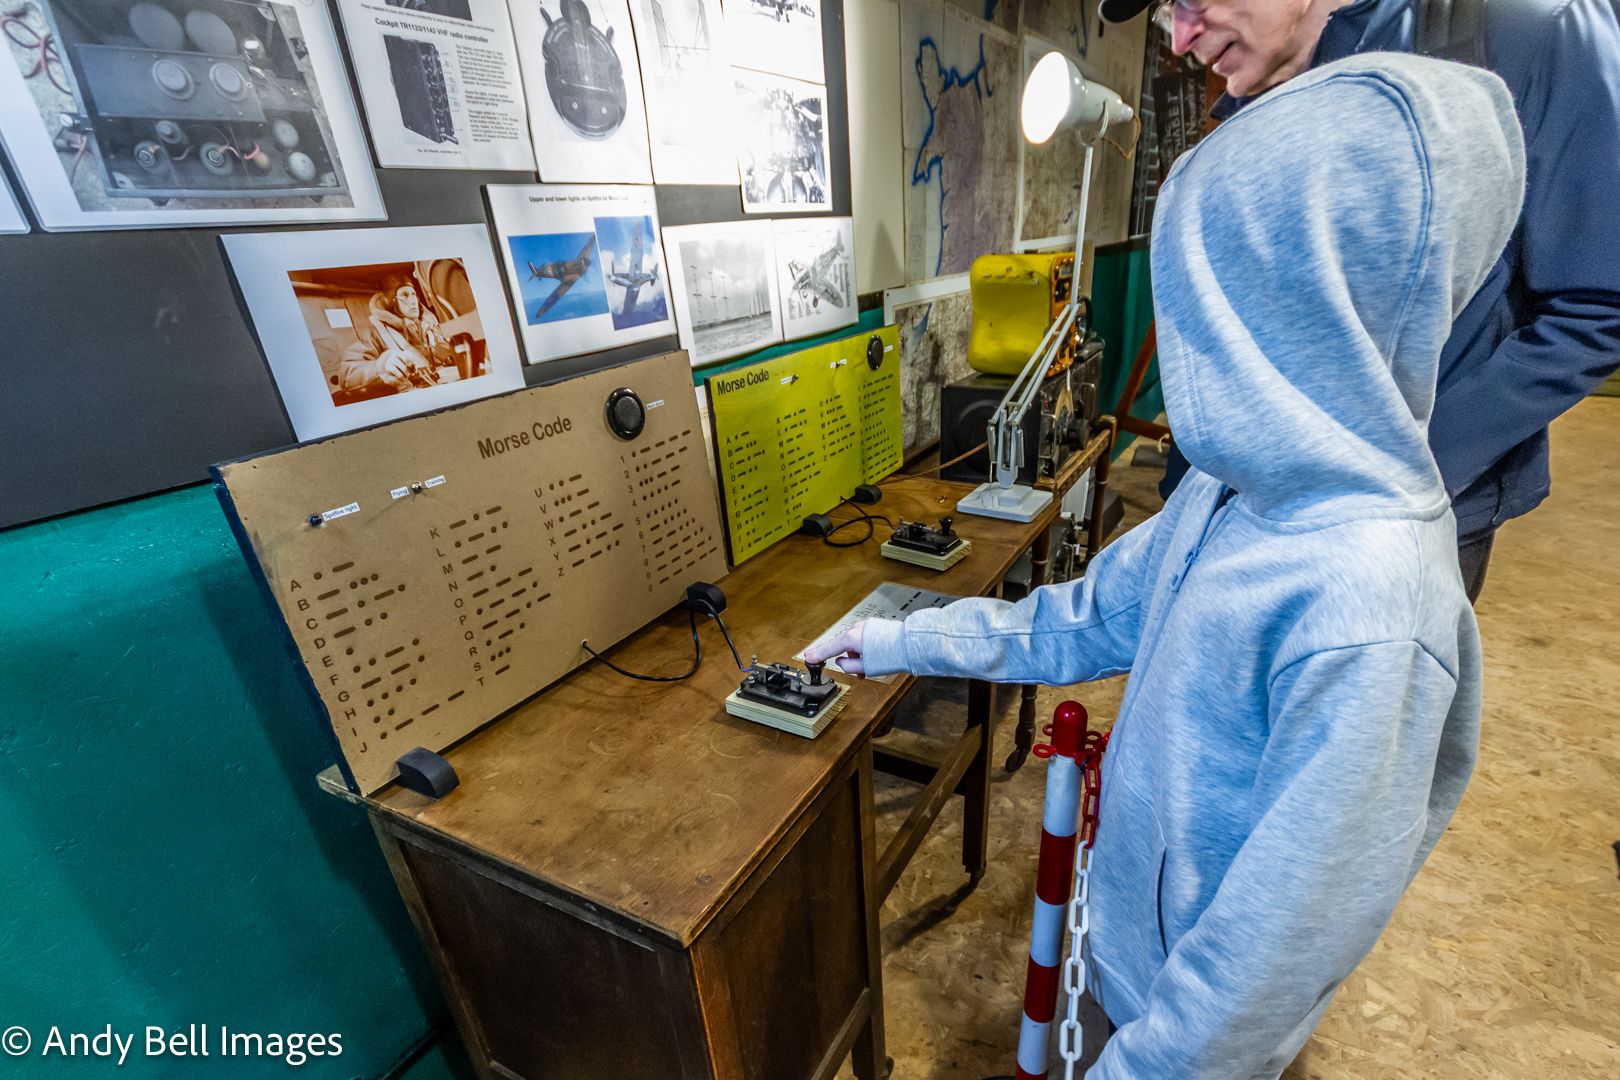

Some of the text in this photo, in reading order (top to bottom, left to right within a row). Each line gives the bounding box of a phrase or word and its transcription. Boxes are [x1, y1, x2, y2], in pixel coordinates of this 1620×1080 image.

[375, 17, 399, 29] Cockpit
[437, 27, 448, 36] VHF
[450, 30, 463, 40] radio
[464, 33, 488, 44] controller
[717, 378, 746, 396] Morse
[746, 369, 769, 386] Code
[477, 416, 572, 460] Morse Code
[624, 470, 630, 478] 2
[392, 488, 408, 497] Flying
[534, 488, 543, 498] U
[628, 485, 634, 493] 3
[345, 504, 358, 513] light
[540, 505, 546, 514] V
[544, 520, 554, 530] W
[430, 528, 440, 539] K
[549, 537, 556, 546] X
[436, 548, 445, 557] L
[553, 552, 560, 561] Y
[442, 563, 453, 575] M
[558, 568, 565, 577] Z
[291, 579, 302, 592] A
[448, 581, 458, 592] N
[297, 598, 309, 611] B
[454, 598, 463, 608] O
[306, 618, 318, 629] C
[459, 615, 467, 625] P
[464, 631, 474, 641] Q
[314, 638, 326, 649] D
[469, 647, 478, 656] R
[322, 656, 334, 667] E
[474, 662, 482, 671] S
[330, 674, 339, 685] F
[477, 677, 485, 686] T
[338, 691, 350, 702] G
[345, 708, 357, 720] H
[352, 728, 357, 736] I
[360, 742, 367, 753] J
